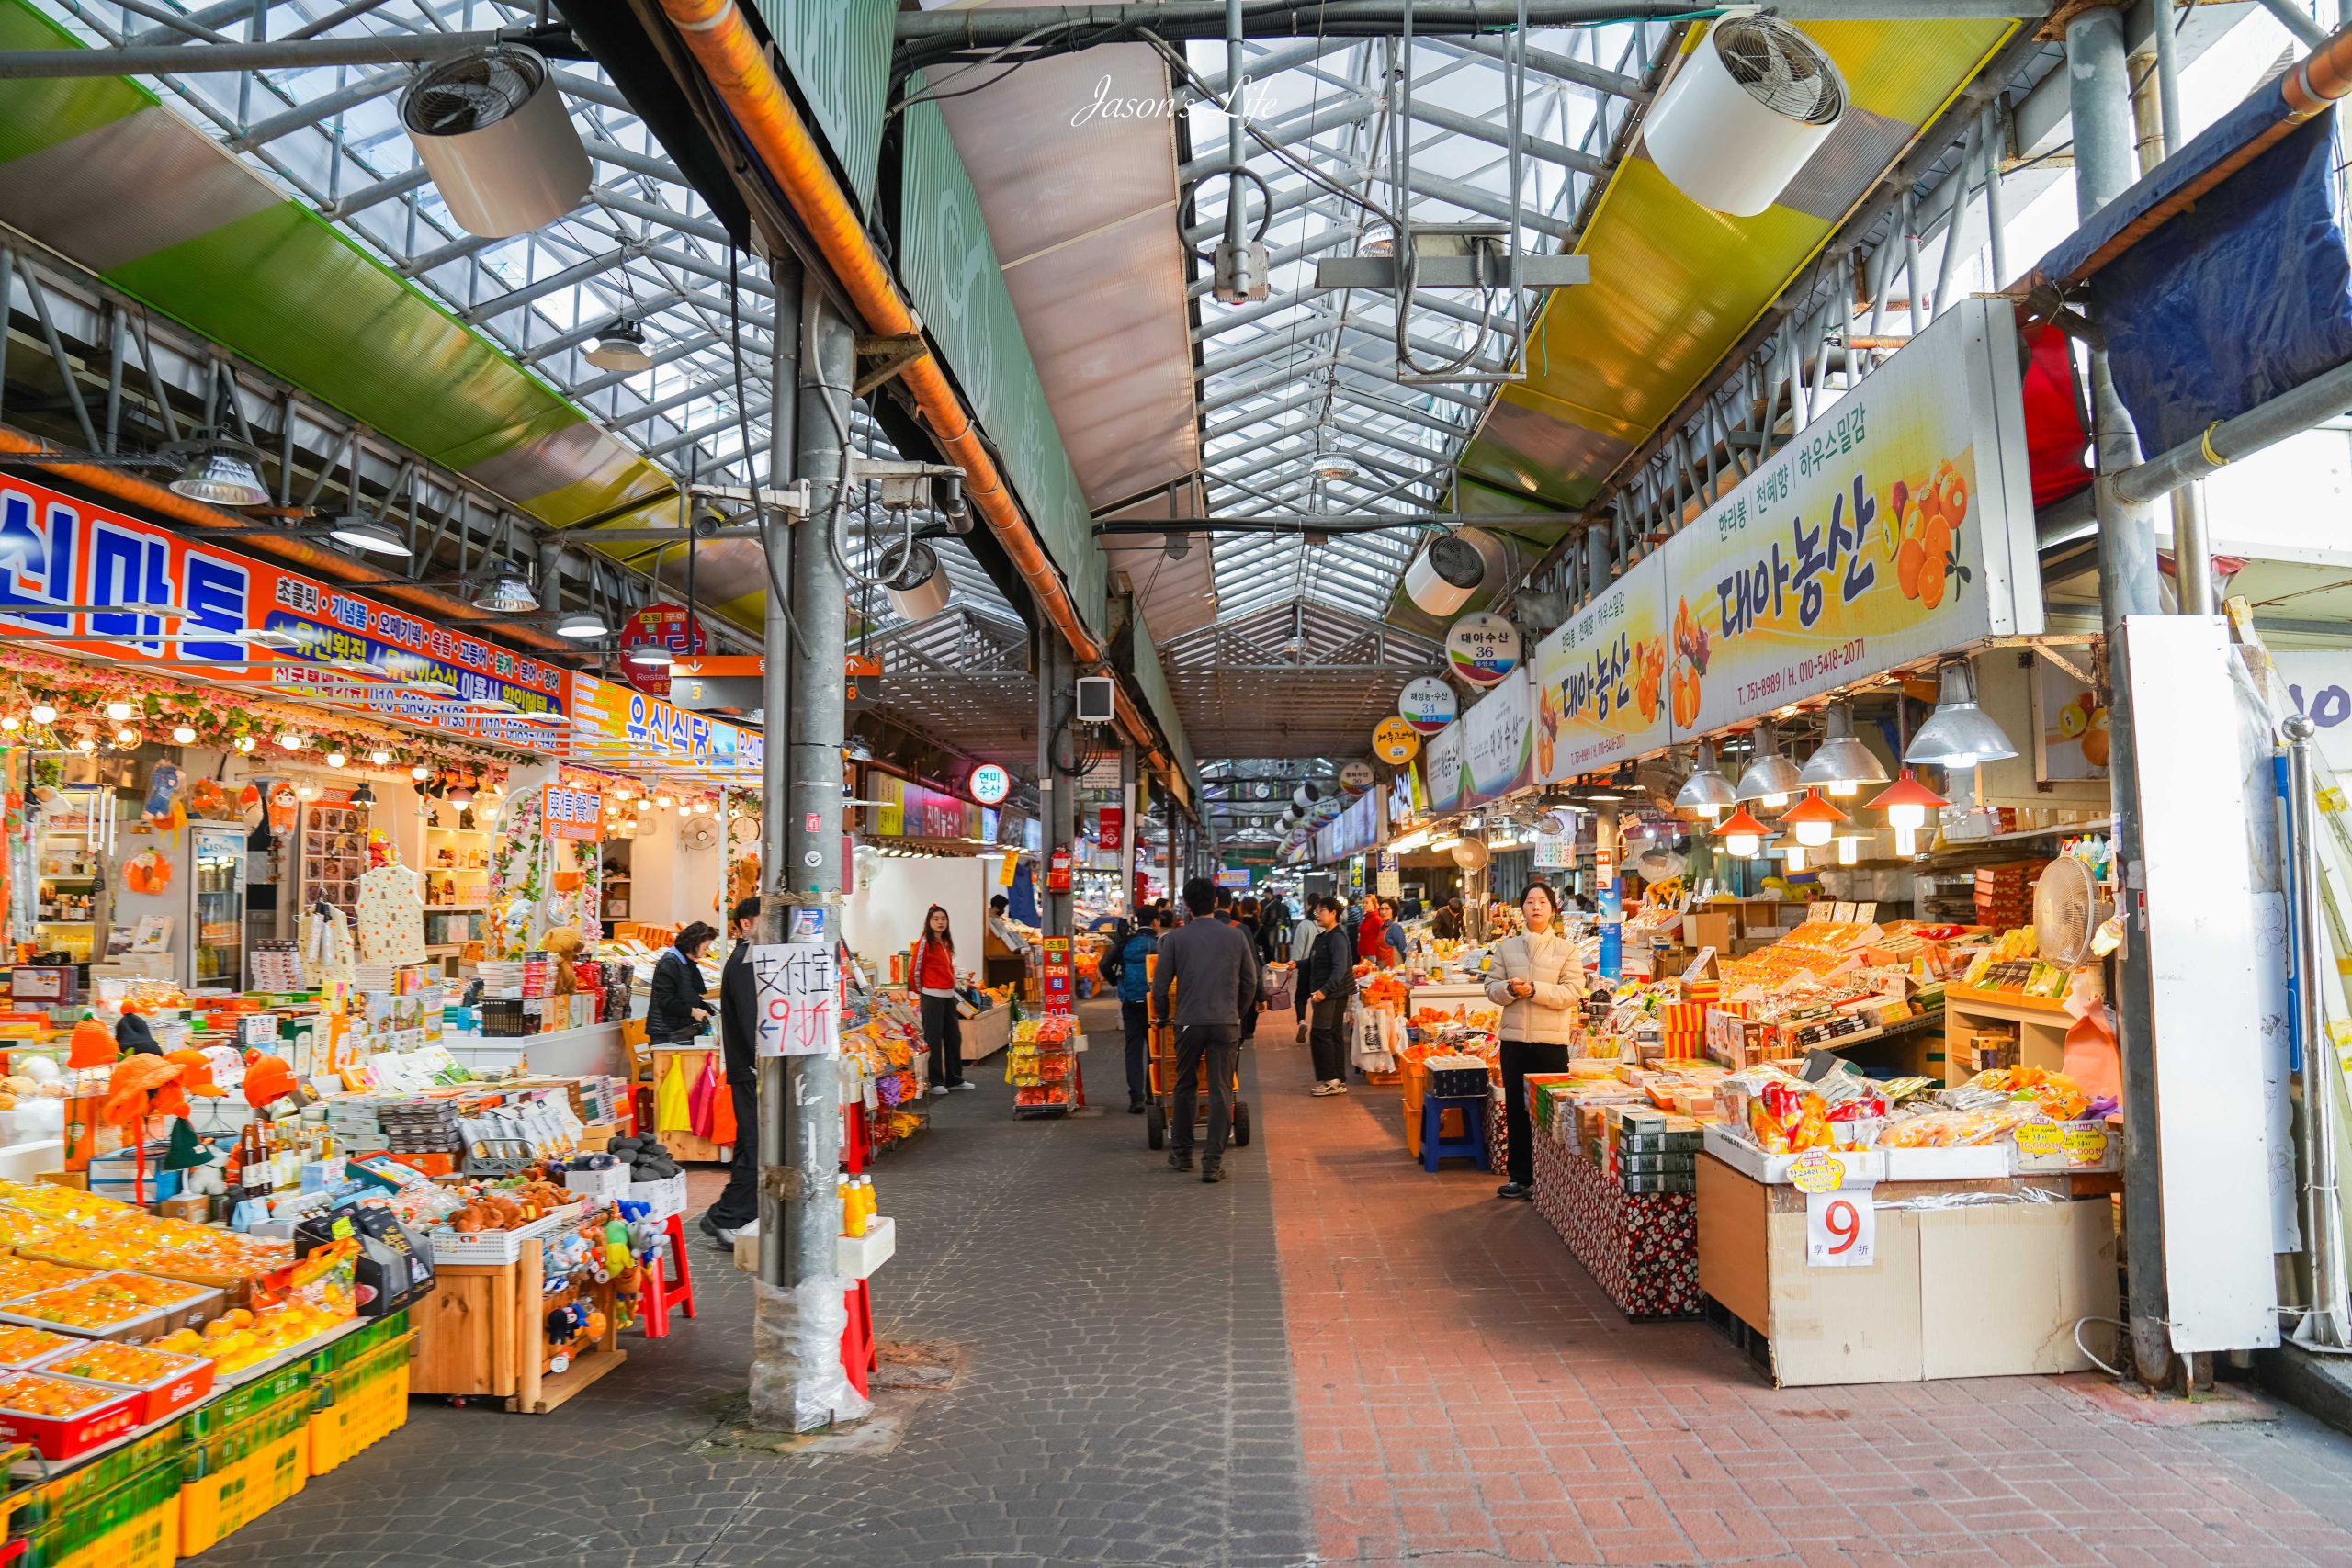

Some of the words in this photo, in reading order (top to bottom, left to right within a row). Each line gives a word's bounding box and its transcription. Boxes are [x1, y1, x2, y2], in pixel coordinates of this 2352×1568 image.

[1718, 507, 1747, 542] 한라봉
[1756, 476, 1790, 516] 천혜향
[1799, 403, 1867, 478] 하우스밀감
[1716, 471, 1875, 639] 대아농산
[666, 612, 686, 621] 구이
[1562, 626, 1576, 654] 한라봉
[1578, 613, 1594, 641] 천혜향
[1597, 589, 1625, 626] 하우스밀감
[276, 576, 319, 616] 초콜릿
[331, 594, 368, 632] 기념품
[379, 612, 423, 649] 오메기떡
[432, 630, 452, 660] 옥돔
[459, 640, 488, 671] 고등어
[494, 651, 514, 679] 꽃게
[519, 663, 537, 687] 문어
[544, 670, 560, 694] 장어
[1461, 632, 1509, 644] 대아수산
[1476, 646, 1494, 658] 36
[1561, 631, 1631, 721] 대아농산
[1746, 671, 1781, 703] 751-8989
[1788, 665, 1798, 689] H.
[1799, 637, 1866, 682] 010-5418-2071
[460, 672, 501, 703] 이용시
[503, 685, 548, 714] 할인혜택
[692, 687, 701, 700] 3
[847, 687, 857, 700] 8
[1422, 703, 1435, 714] 34
[627, 694, 710, 766] 유신식당
[978, 773, 1001, 784] 현미
[978, 784, 1001, 797] 수산
[1046, 939, 1067, 950] 조림
[1050, 953, 1062, 963] 탕
[755, 948, 833, 998] 支付宝
[1046, 966, 1068, 976] 구이
[1052, 979, 1063, 988] 회
[768, 998, 831, 1053] 9折
[1813, 1244, 1824, 1256] 享
[1825, 1200, 1860, 1255] 9
[1858, 1244, 1869, 1256] 折
